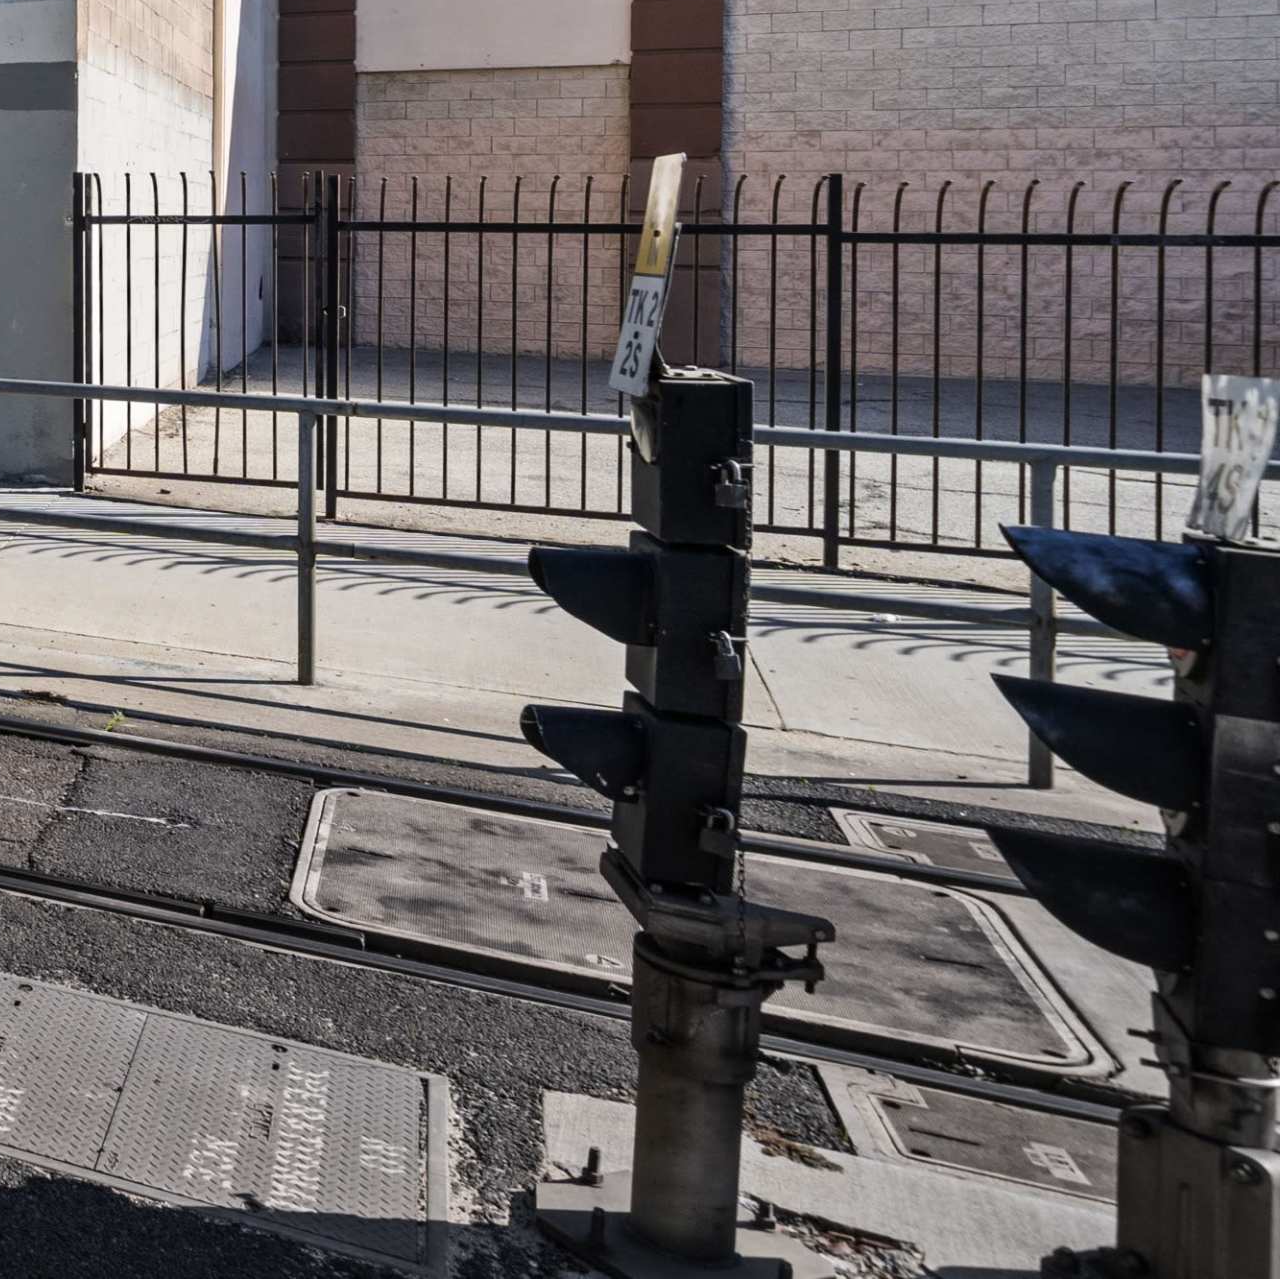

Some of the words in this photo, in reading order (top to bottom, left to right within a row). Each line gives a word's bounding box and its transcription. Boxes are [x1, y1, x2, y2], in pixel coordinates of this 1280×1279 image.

[627, 287, 650, 325] TK
[647, 290, 660, 328] 2
[618, 340, 643, 379] 2S
